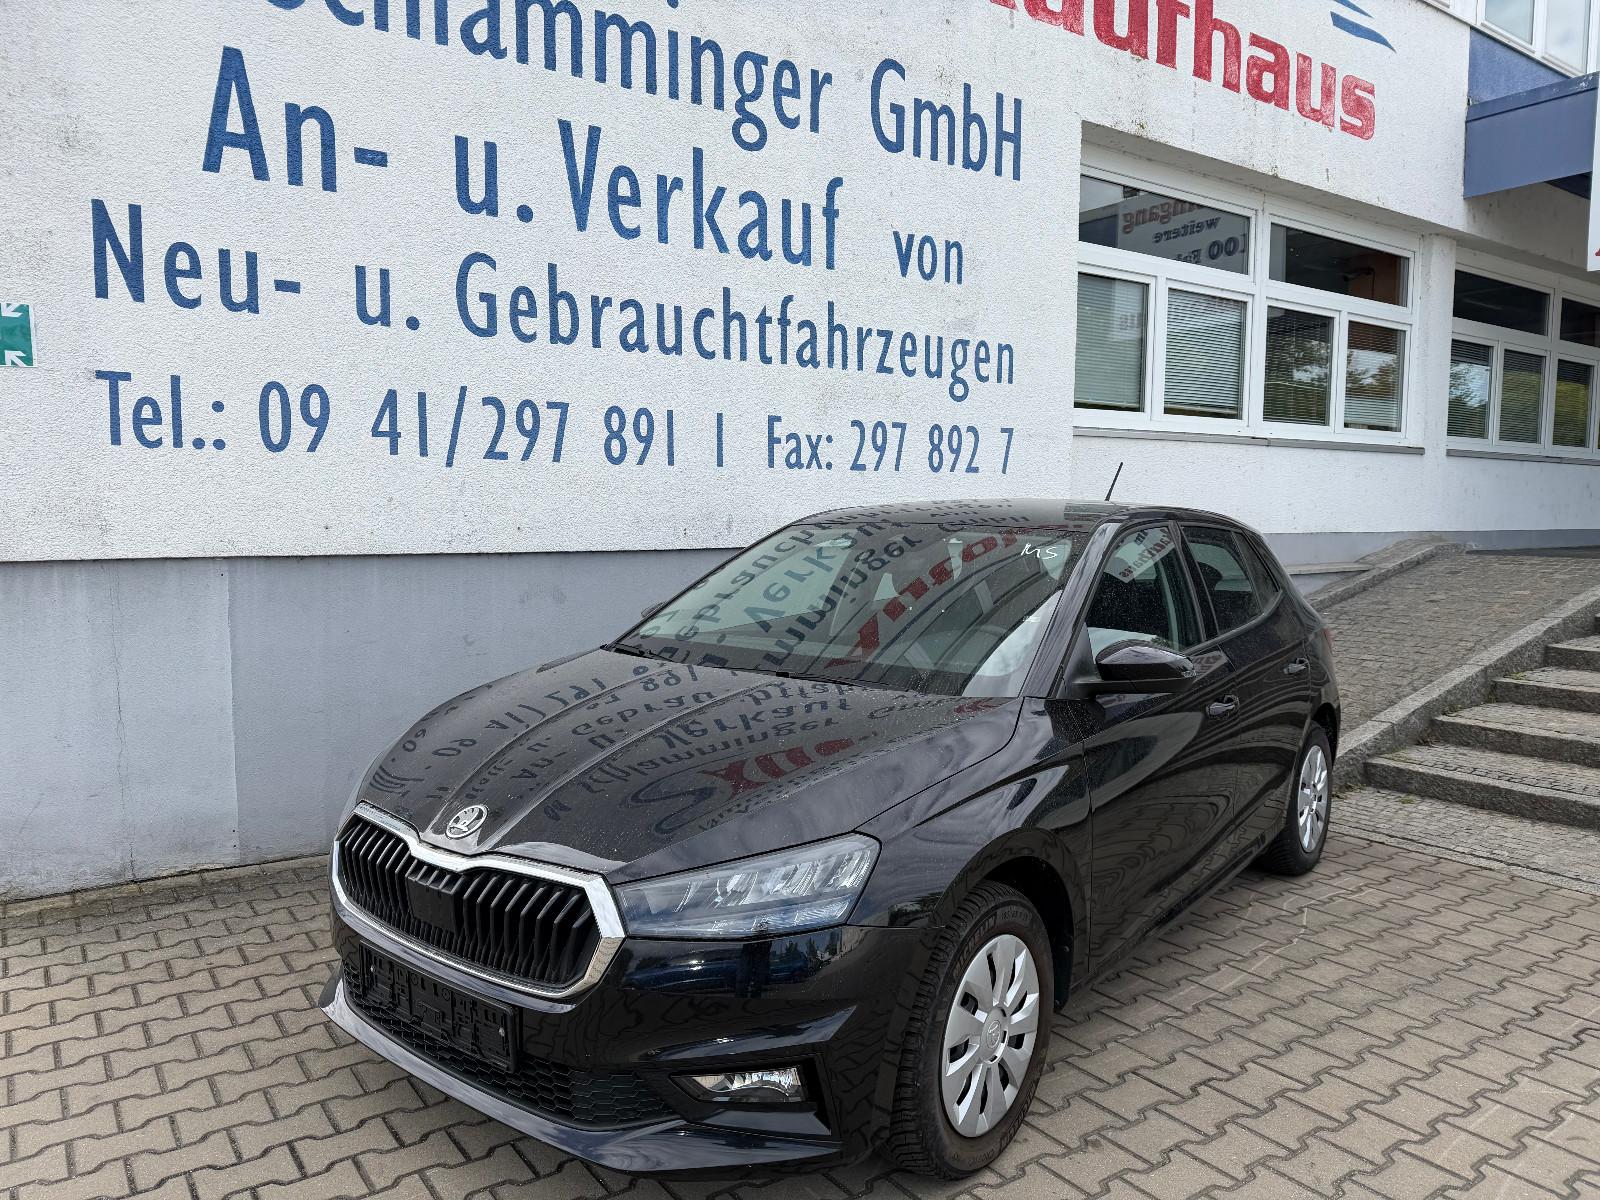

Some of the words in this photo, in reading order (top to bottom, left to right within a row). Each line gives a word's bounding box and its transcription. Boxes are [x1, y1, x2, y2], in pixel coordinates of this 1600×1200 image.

[201, 45, 390, 193] An-
[454, 134, 535, 224] u.
[558, 119, 844, 271] Verkauf
[892, 230, 964, 286] von
[870, 58, 1023, 182] GmbH
[90, 198, 302, 315] Neu-
[354, 264, 421, 332] u.
[455, 251, 1014, 403] Gebrauchtfahrzeugen
[95, 369, 226, 451] Tel.:
[258, 380, 331, 454] 09
[603, 405, 676, 466] 891
[767, 414, 834, 471] Fax:
[849, 419, 908, 473] 297
[927, 423, 981, 474] 892
[1000, 427, 1015, 475] 7
